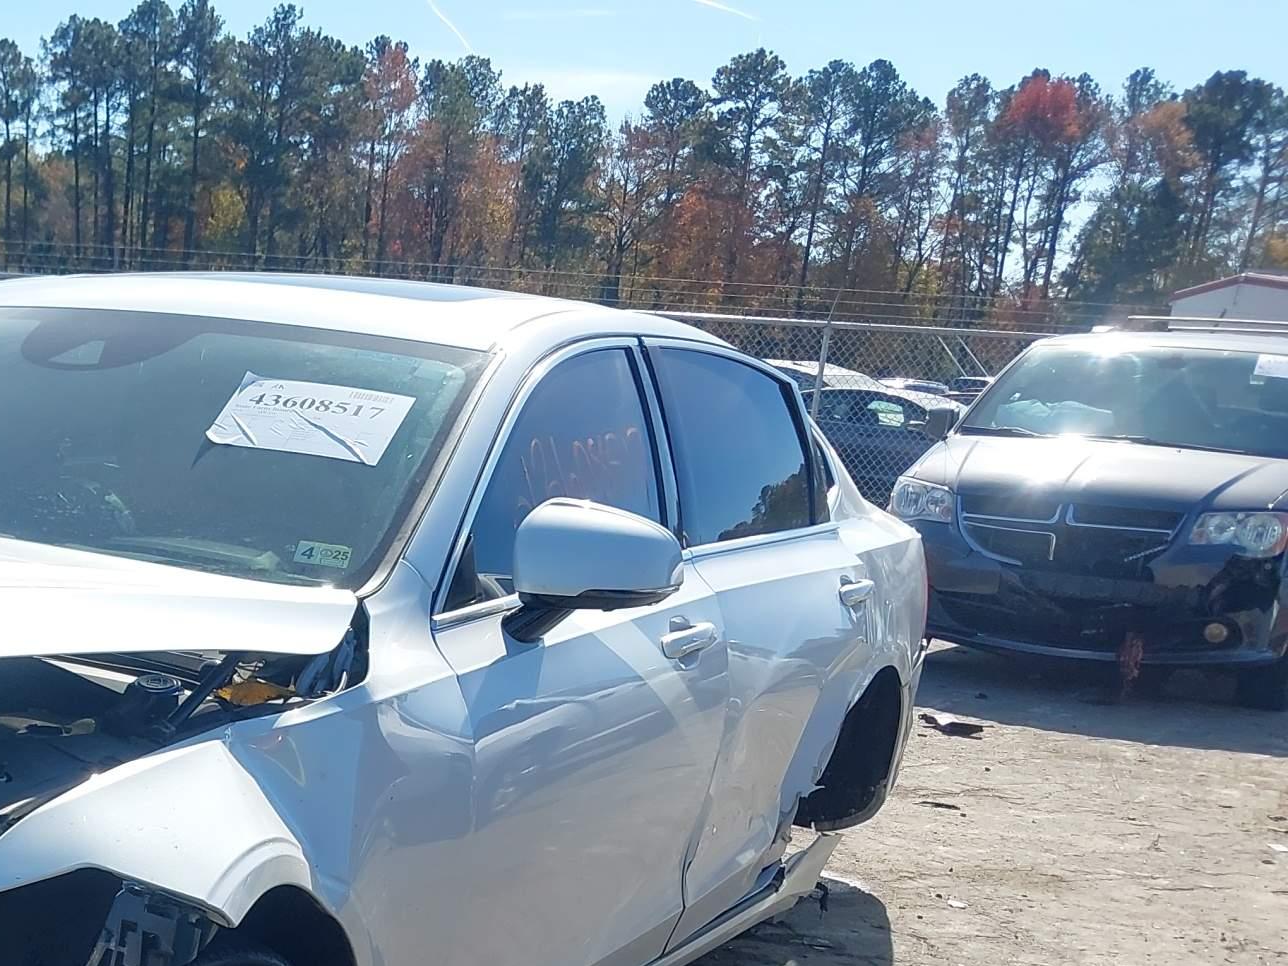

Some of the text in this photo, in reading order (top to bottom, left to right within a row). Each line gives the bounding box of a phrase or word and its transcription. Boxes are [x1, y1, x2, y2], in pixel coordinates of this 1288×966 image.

[248, 392, 384, 420] 43608517
[301, 546, 350, 561] 4 25
